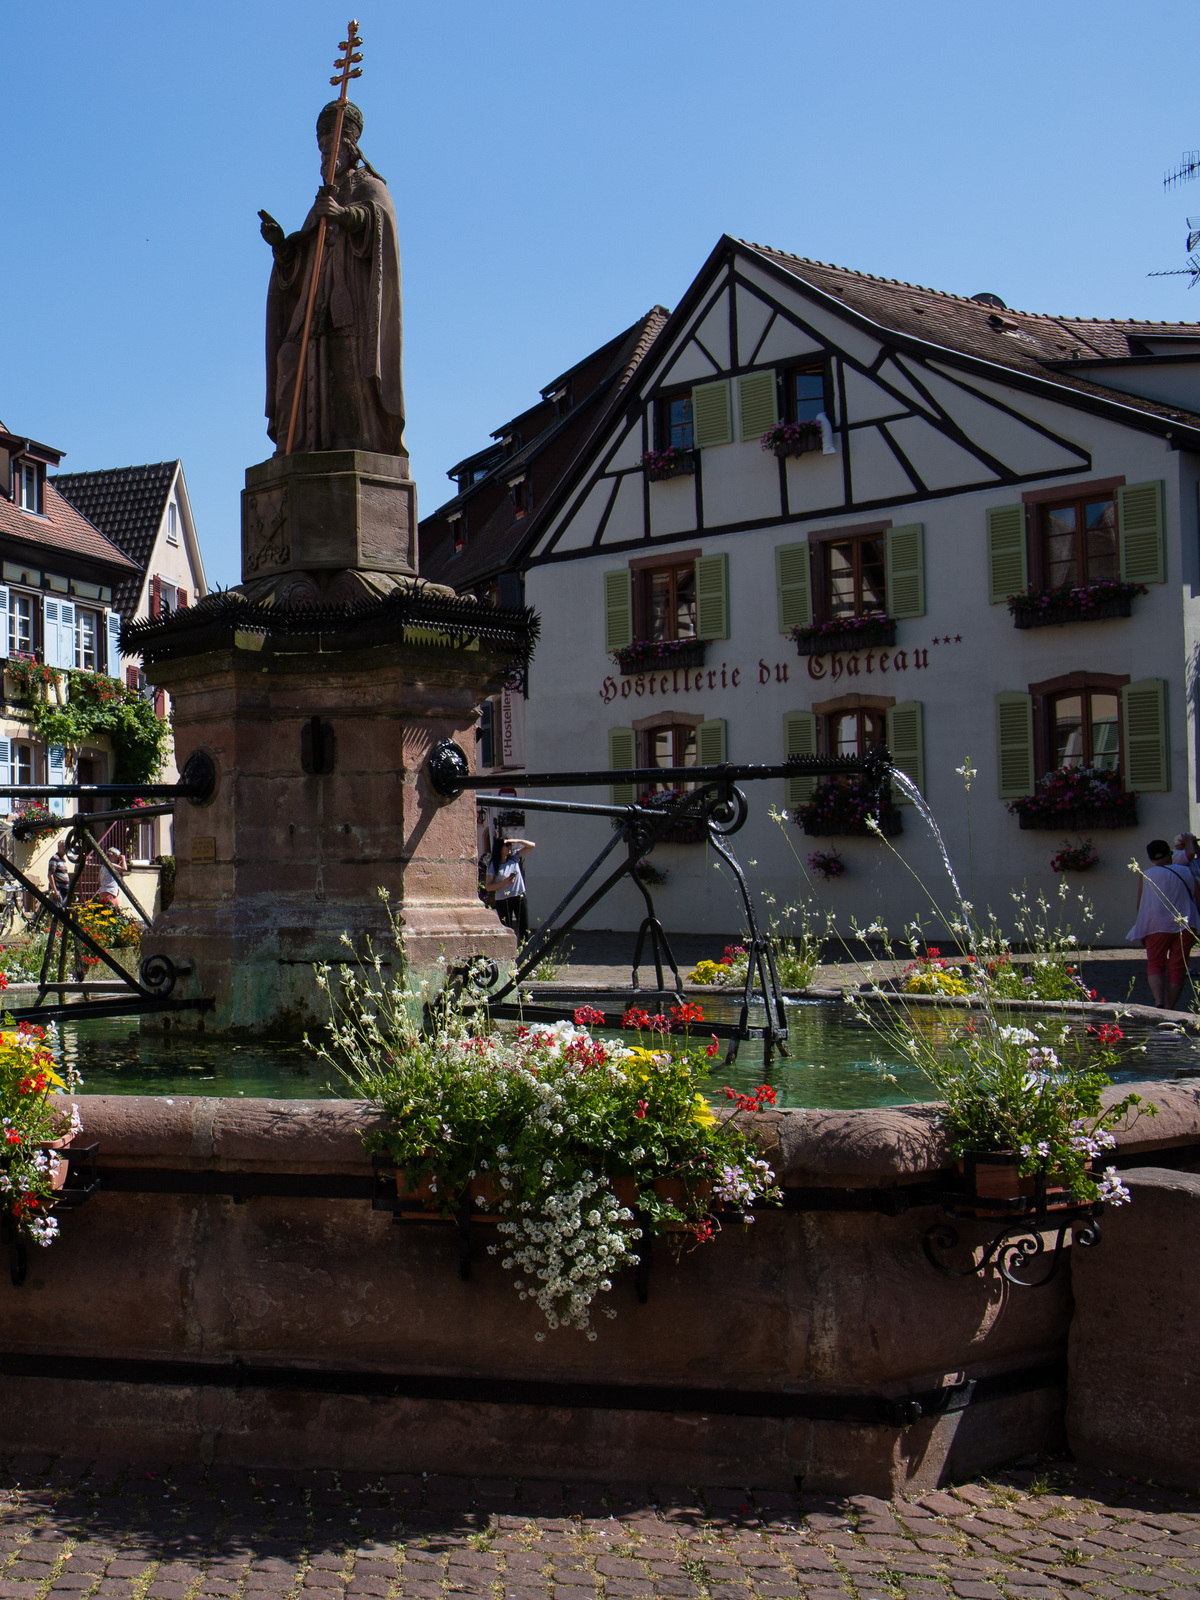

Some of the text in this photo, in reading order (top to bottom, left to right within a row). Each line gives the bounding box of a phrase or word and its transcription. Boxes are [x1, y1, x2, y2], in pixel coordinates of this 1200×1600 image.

[599, 648, 930, 705] Hostellerie du Château
[502, 688, 513, 757] L'Hosteller
